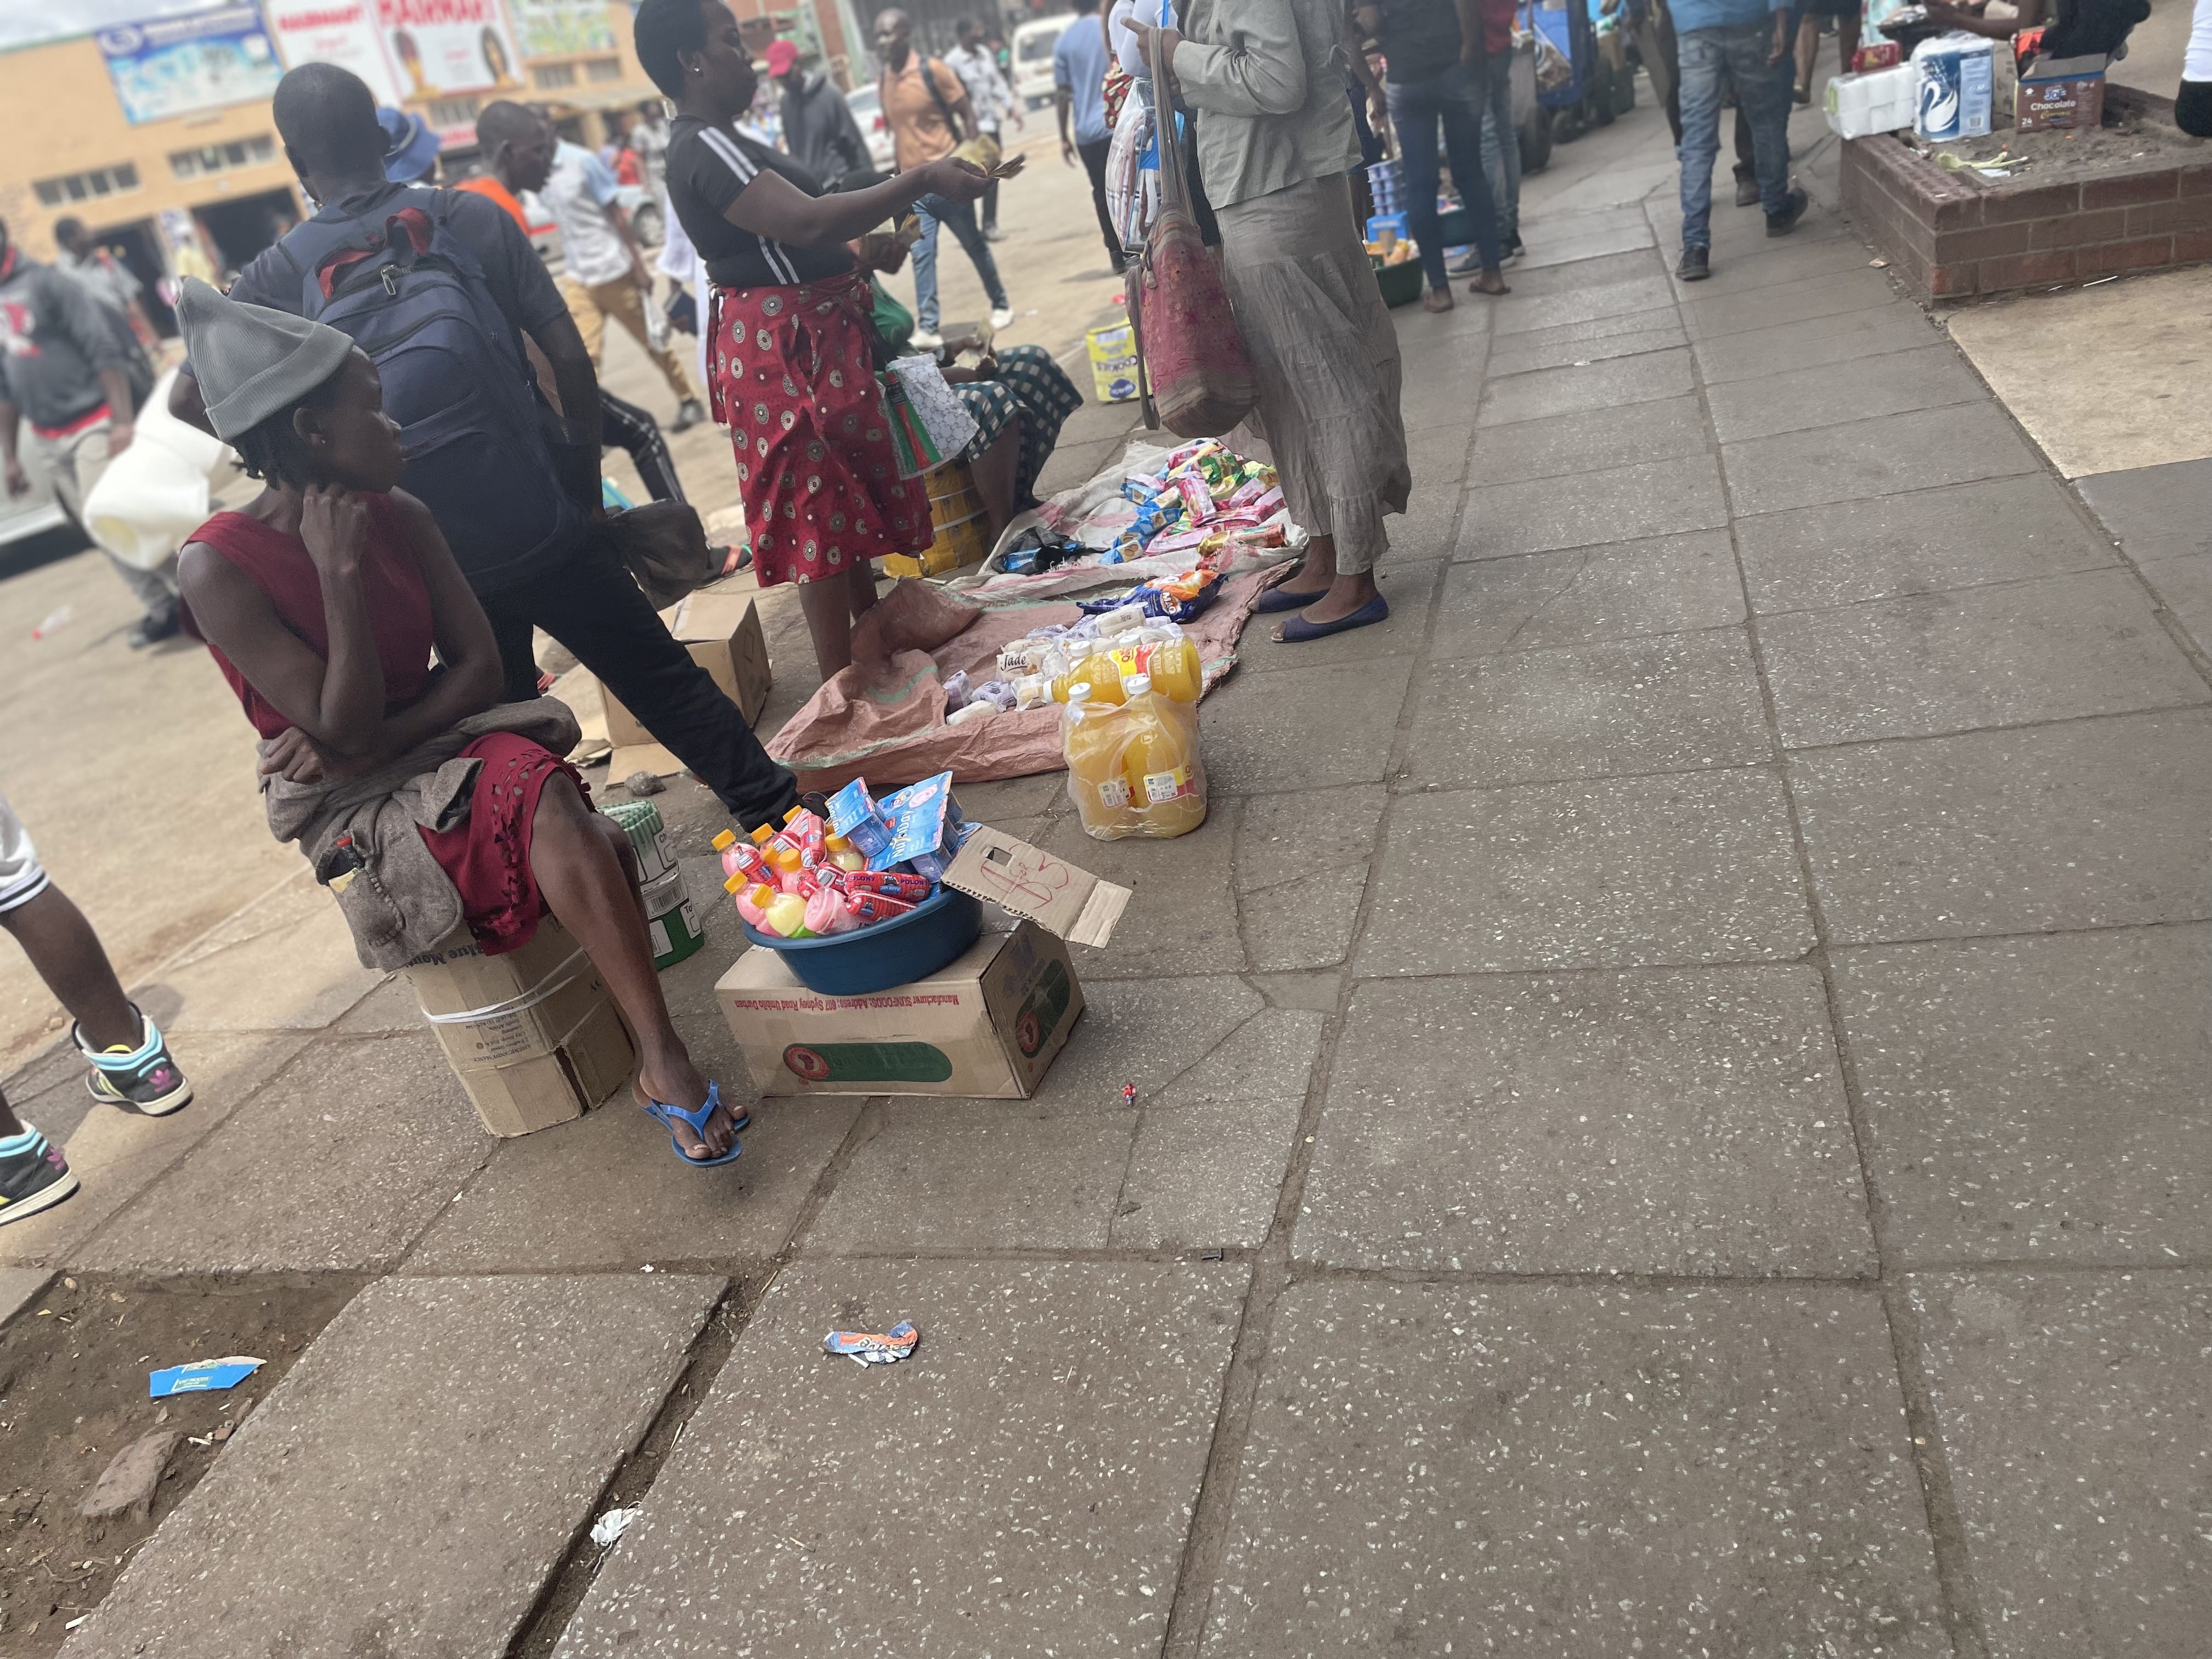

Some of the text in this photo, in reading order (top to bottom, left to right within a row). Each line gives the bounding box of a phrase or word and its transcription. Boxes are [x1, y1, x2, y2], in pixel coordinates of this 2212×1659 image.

[2030, 100, 2076, 111] Chocolate
[2022, 117, 2033, 126] 24
[1097, 354, 1138, 372] COOKIES
[1161, 591, 1177, 615] MAQ
[1000, 654, 1028, 670] Jade
[891, 809, 915, 861] NutriDay
[734, 1000, 759, 1010] Durban
[758, 1000, 781, 1011] Umbilo
[781, 1000, 799, 1011] Road
[799, 997, 823, 1012] Sydney
[826, 999, 837, 1011] 607
[913, 995, 960, 1006] Manufacturer
